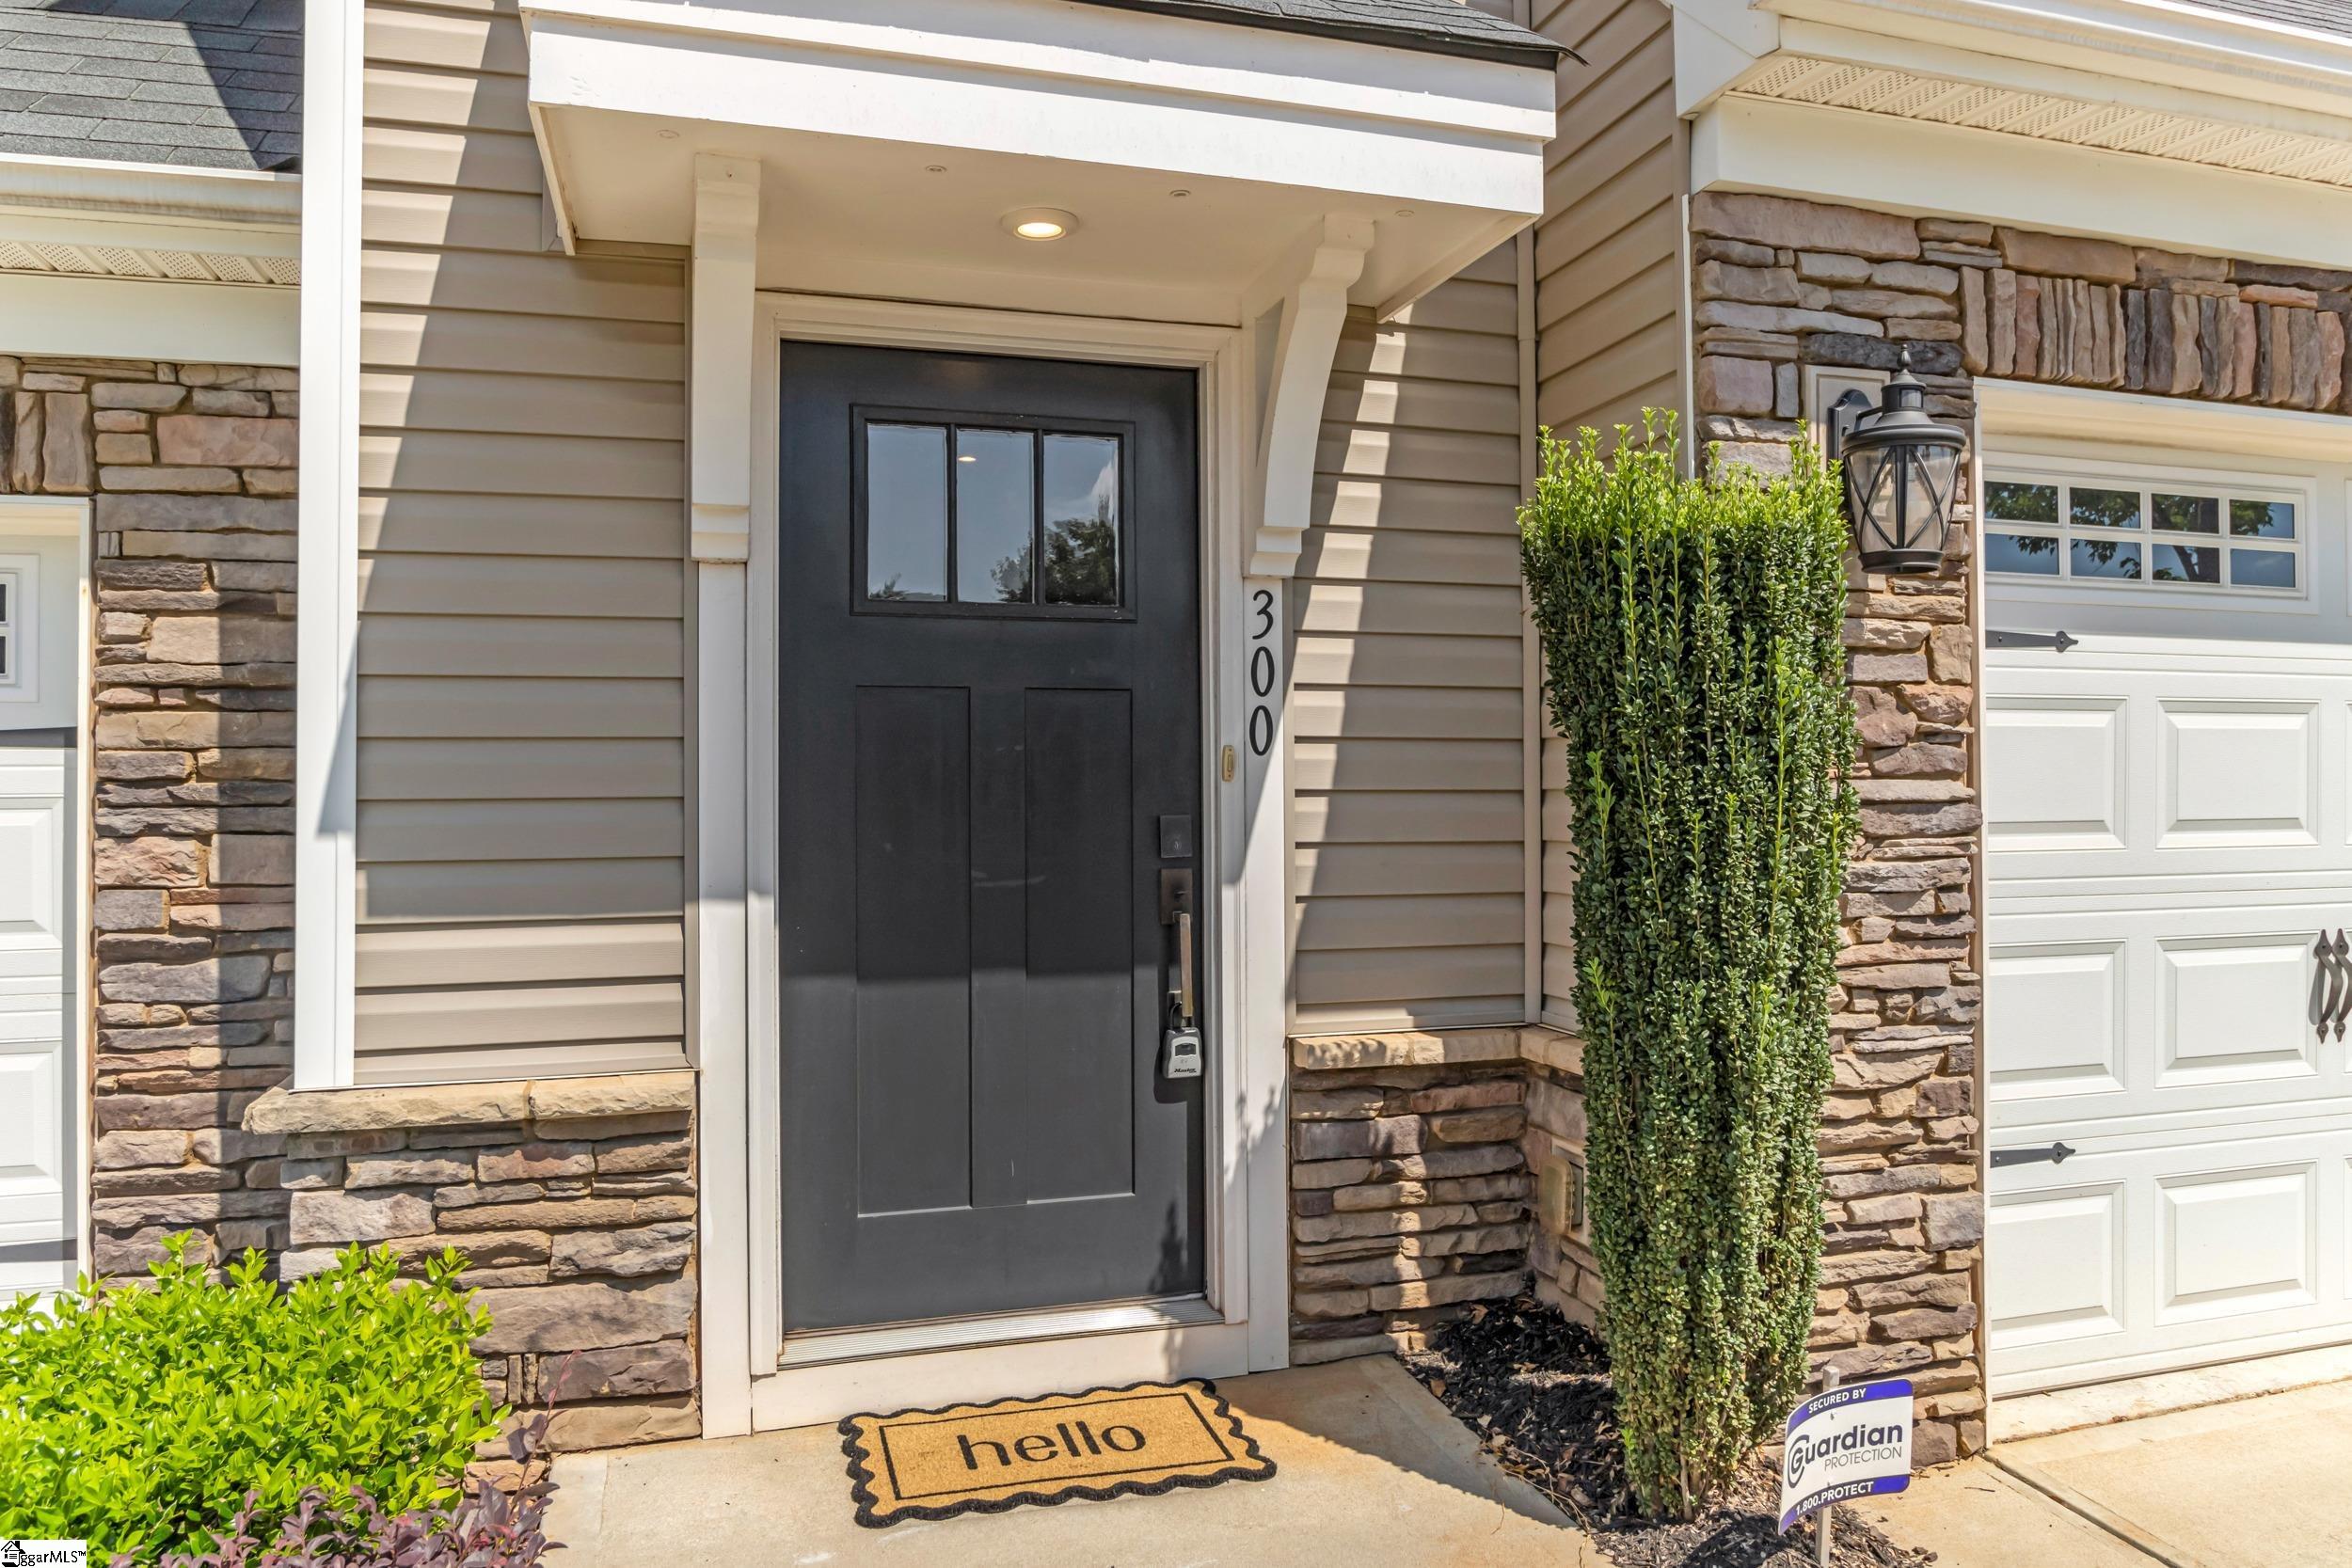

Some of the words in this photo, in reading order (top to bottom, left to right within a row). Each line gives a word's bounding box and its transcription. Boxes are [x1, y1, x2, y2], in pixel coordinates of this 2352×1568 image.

[1249, 590, 1275, 756] 300
[1808, 1391, 1850, 1414] SECURED
[1852, 1388, 1867, 1400] BY
[957, 1420, 1146, 1470] hello
[1788, 1424, 1903, 1489] Guardian
[1824, 1447, 1902, 1471] PROTECTION
[1795, 1481, 1874, 1516] 1.800.PROTECT
